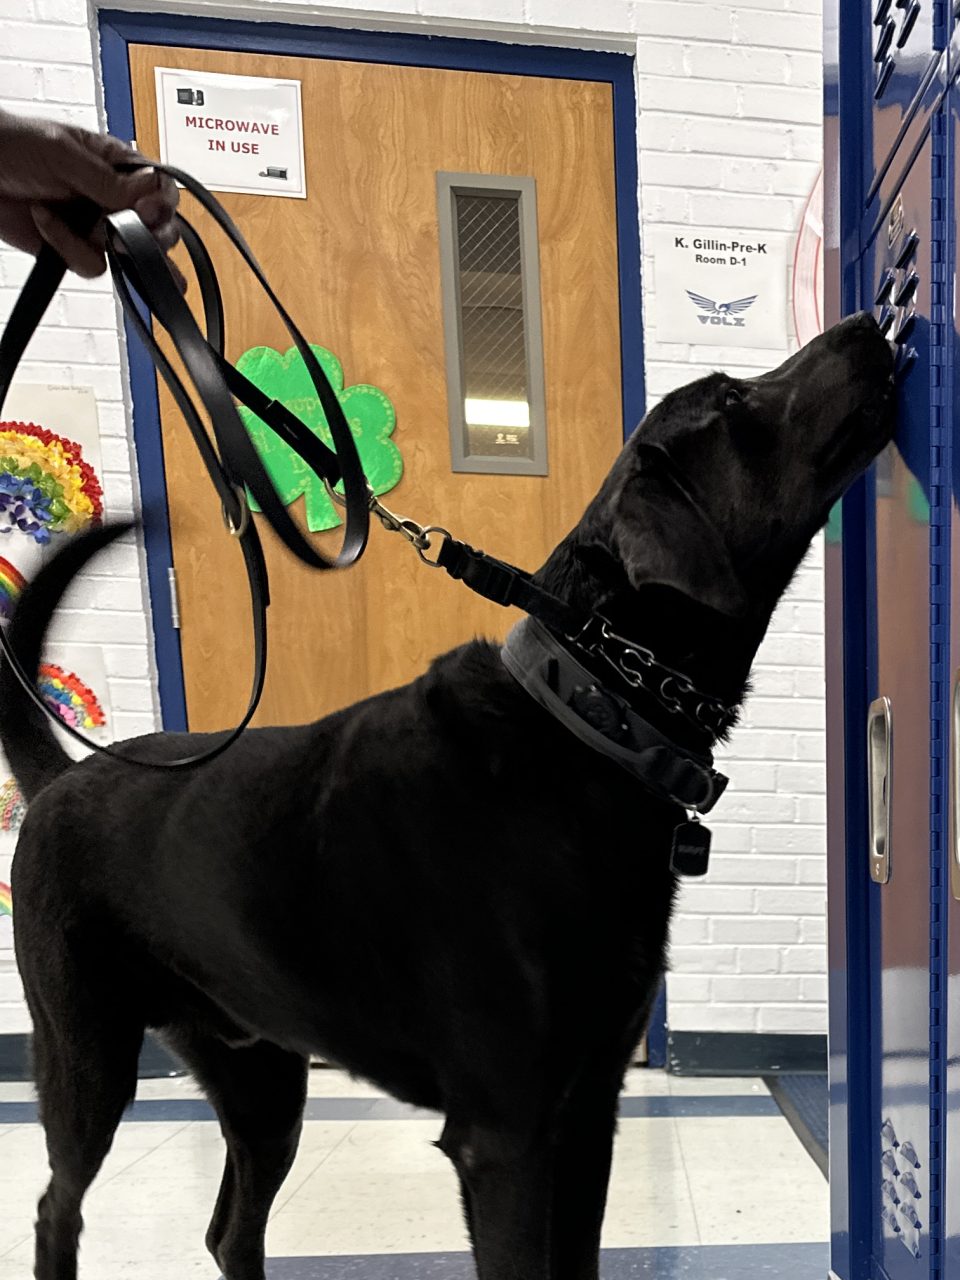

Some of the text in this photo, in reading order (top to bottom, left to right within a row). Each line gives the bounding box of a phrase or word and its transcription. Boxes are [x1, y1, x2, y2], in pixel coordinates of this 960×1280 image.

[185, 116, 279, 135] MICROWAVE
[208, 140, 259, 154] IN USE
[674, 237, 767, 254] K. Gillin-Pre-K
[695, 254, 746, 266] Room D-1
[697, 315, 745, 327] VOLZ
